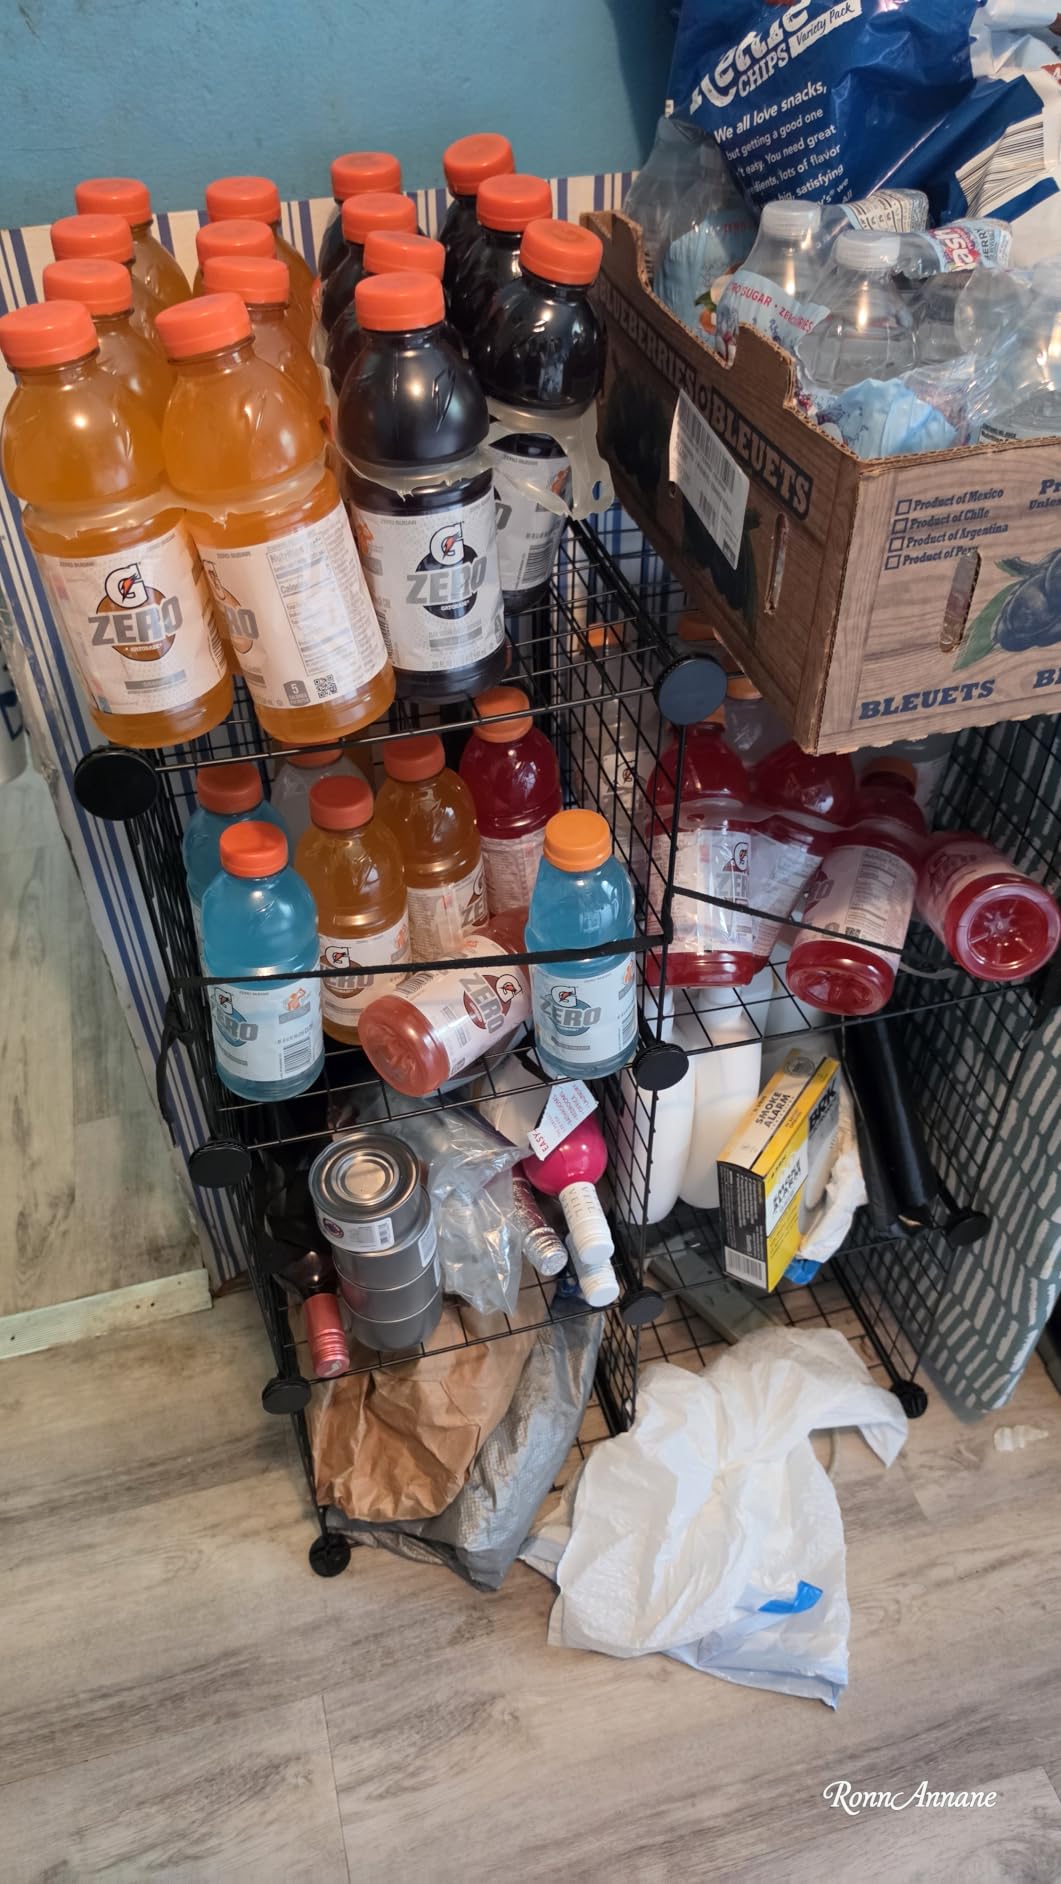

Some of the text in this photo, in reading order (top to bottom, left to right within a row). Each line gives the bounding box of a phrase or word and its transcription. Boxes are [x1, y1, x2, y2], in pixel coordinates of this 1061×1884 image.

[796, 2, 855, 46] Variety Pack
[738, 43, 789, 97] CHIPS
[713, 81, 828, 144] We all love snacks,
[725, 108, 824, 161] but getting a good one
[765, 150, 782, 165] You
[782, 137, 804, 157] need
[806, 124, 837, 149] great
[779, 168, 796, 182] lots
[797, 158, 809, 173] of
[810, 143, 841, 167] flavor
[796, 163, 844, 197] satisfying
[934, 228, 977, 272] lash
[741, 285, 772, 307] SUGAR
[712, 402, 811, 518] BLEUETS
[910, 507, 990, 530] Product of Chile
[913, 488, 1004, 512] Product of Mexico
[906, 522, 1009, 549] Product of Argentina
[902, 550, 942, 566] Product
[943, 546, 955, 559] of
[406, 556, 487, 605] ZERO
[87, 595, 184, 646] ZERO
[858, 679, 995, 720] BLEUETS
[461, 897, 488, 926] ZE
[460, 972, 505, 1034] ZERO
[540, 996, 602, 1028] ZERO
[755, 1091, 782, 1125] SMOKE
[764, 1094, 791, 1128] ALARM
